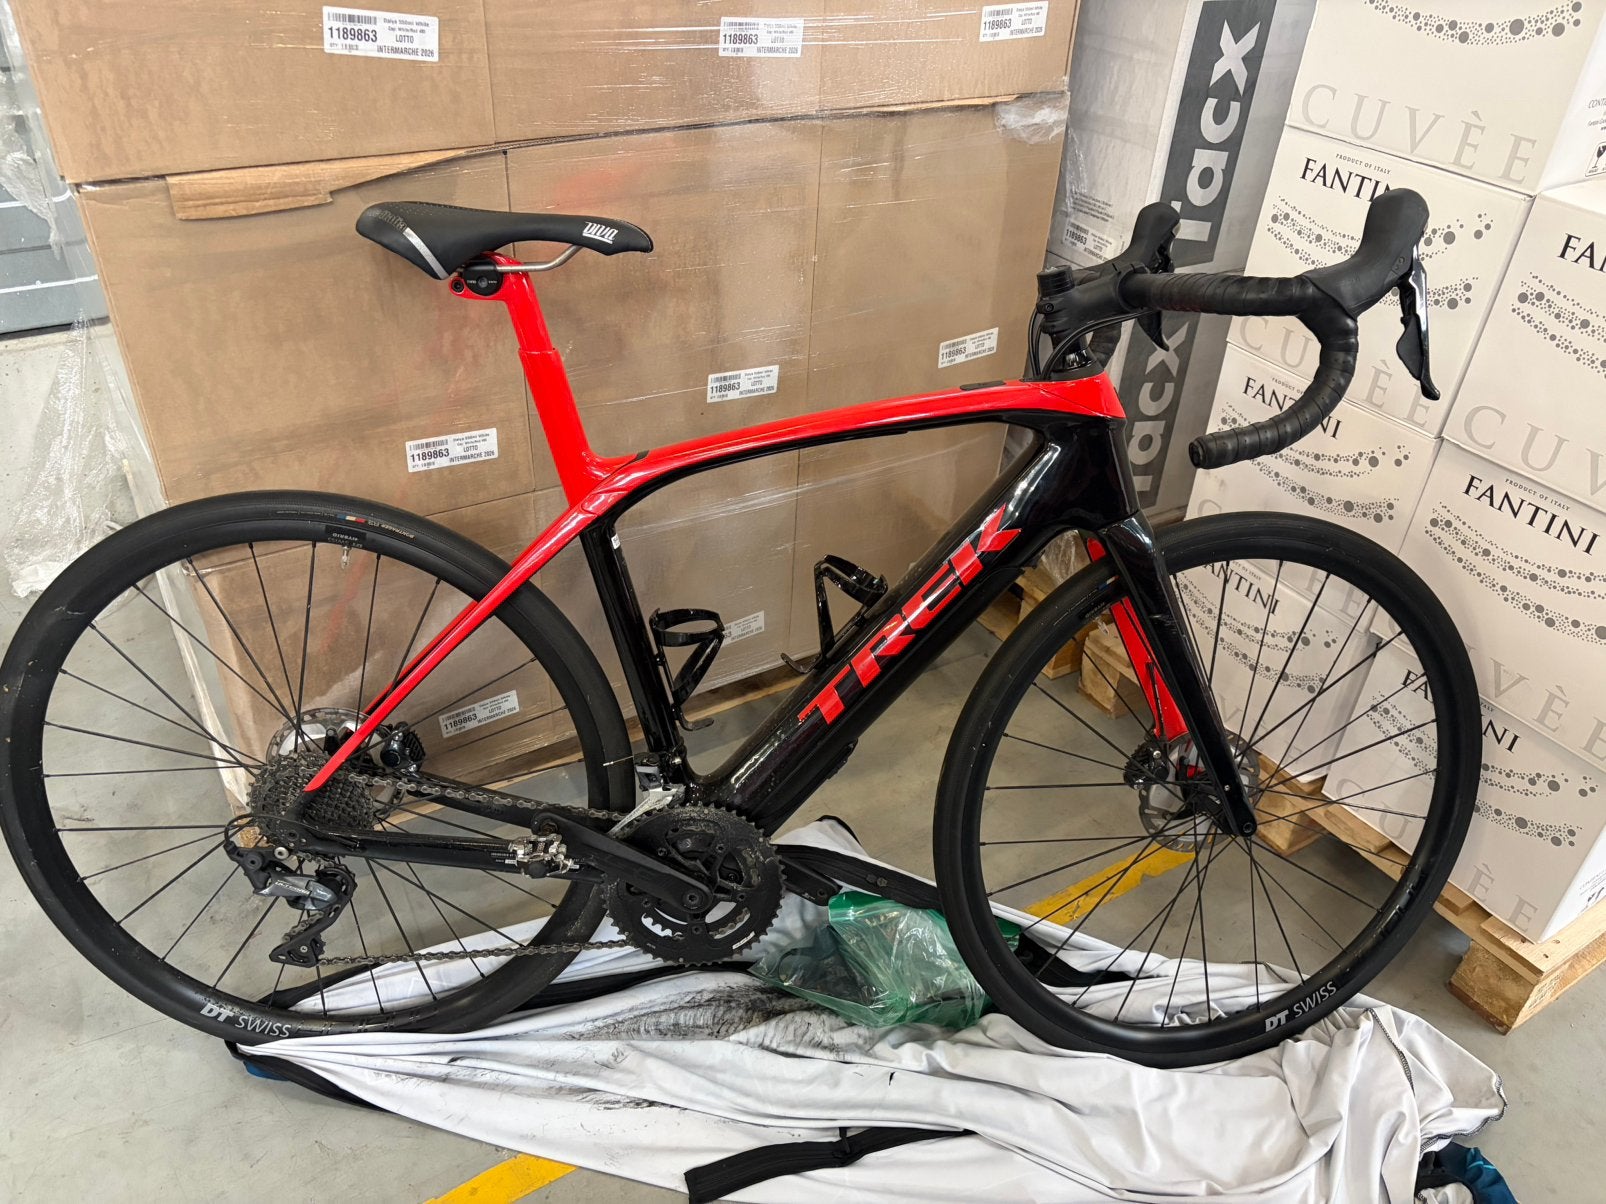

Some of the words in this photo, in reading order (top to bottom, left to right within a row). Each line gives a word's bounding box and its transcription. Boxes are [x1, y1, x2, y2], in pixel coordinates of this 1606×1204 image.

[983, 18, 1012, 31] 1189863
[328, 26, 378, 43] 1189863
[395, 34, 414, 43] LOTTO
[723, 33, 759, 45] 1189863
[377, 45, 420, 56] INTERMARCHE
[420, 48, 435, 58] 2026
[1301, 83, 1538, 184] CUVÈE
[1335, 153, 1363, 166] PRODUCT
[1374, 165, 1391, 175] ITALY
[710, 381, 741, 394] 1189863
[410, 447, 450, 463] 1189863
[449, 452, 483, 463] INTERMARCHE
[484, 450, 495, 458] 2026
[463, 445, 478, 453] LOTTO
[1505, 478, 1538, 496] PRODUCT
[1538, 493, 1549, 501] OF
[1550, 499, 1571, 512] ITALY
[1462, 474, 1601, 556] FANTINI
[797, 503, 1022, 725] TREK
[443, 713, 478, 730] 1189863
[1265, 1009, 1290, 1033] DT
[1293, 981, 1337, 1018] SWISS
[200, 1003, 235, 1022] DT
[235, 1015, 292, 1038] SWISS
